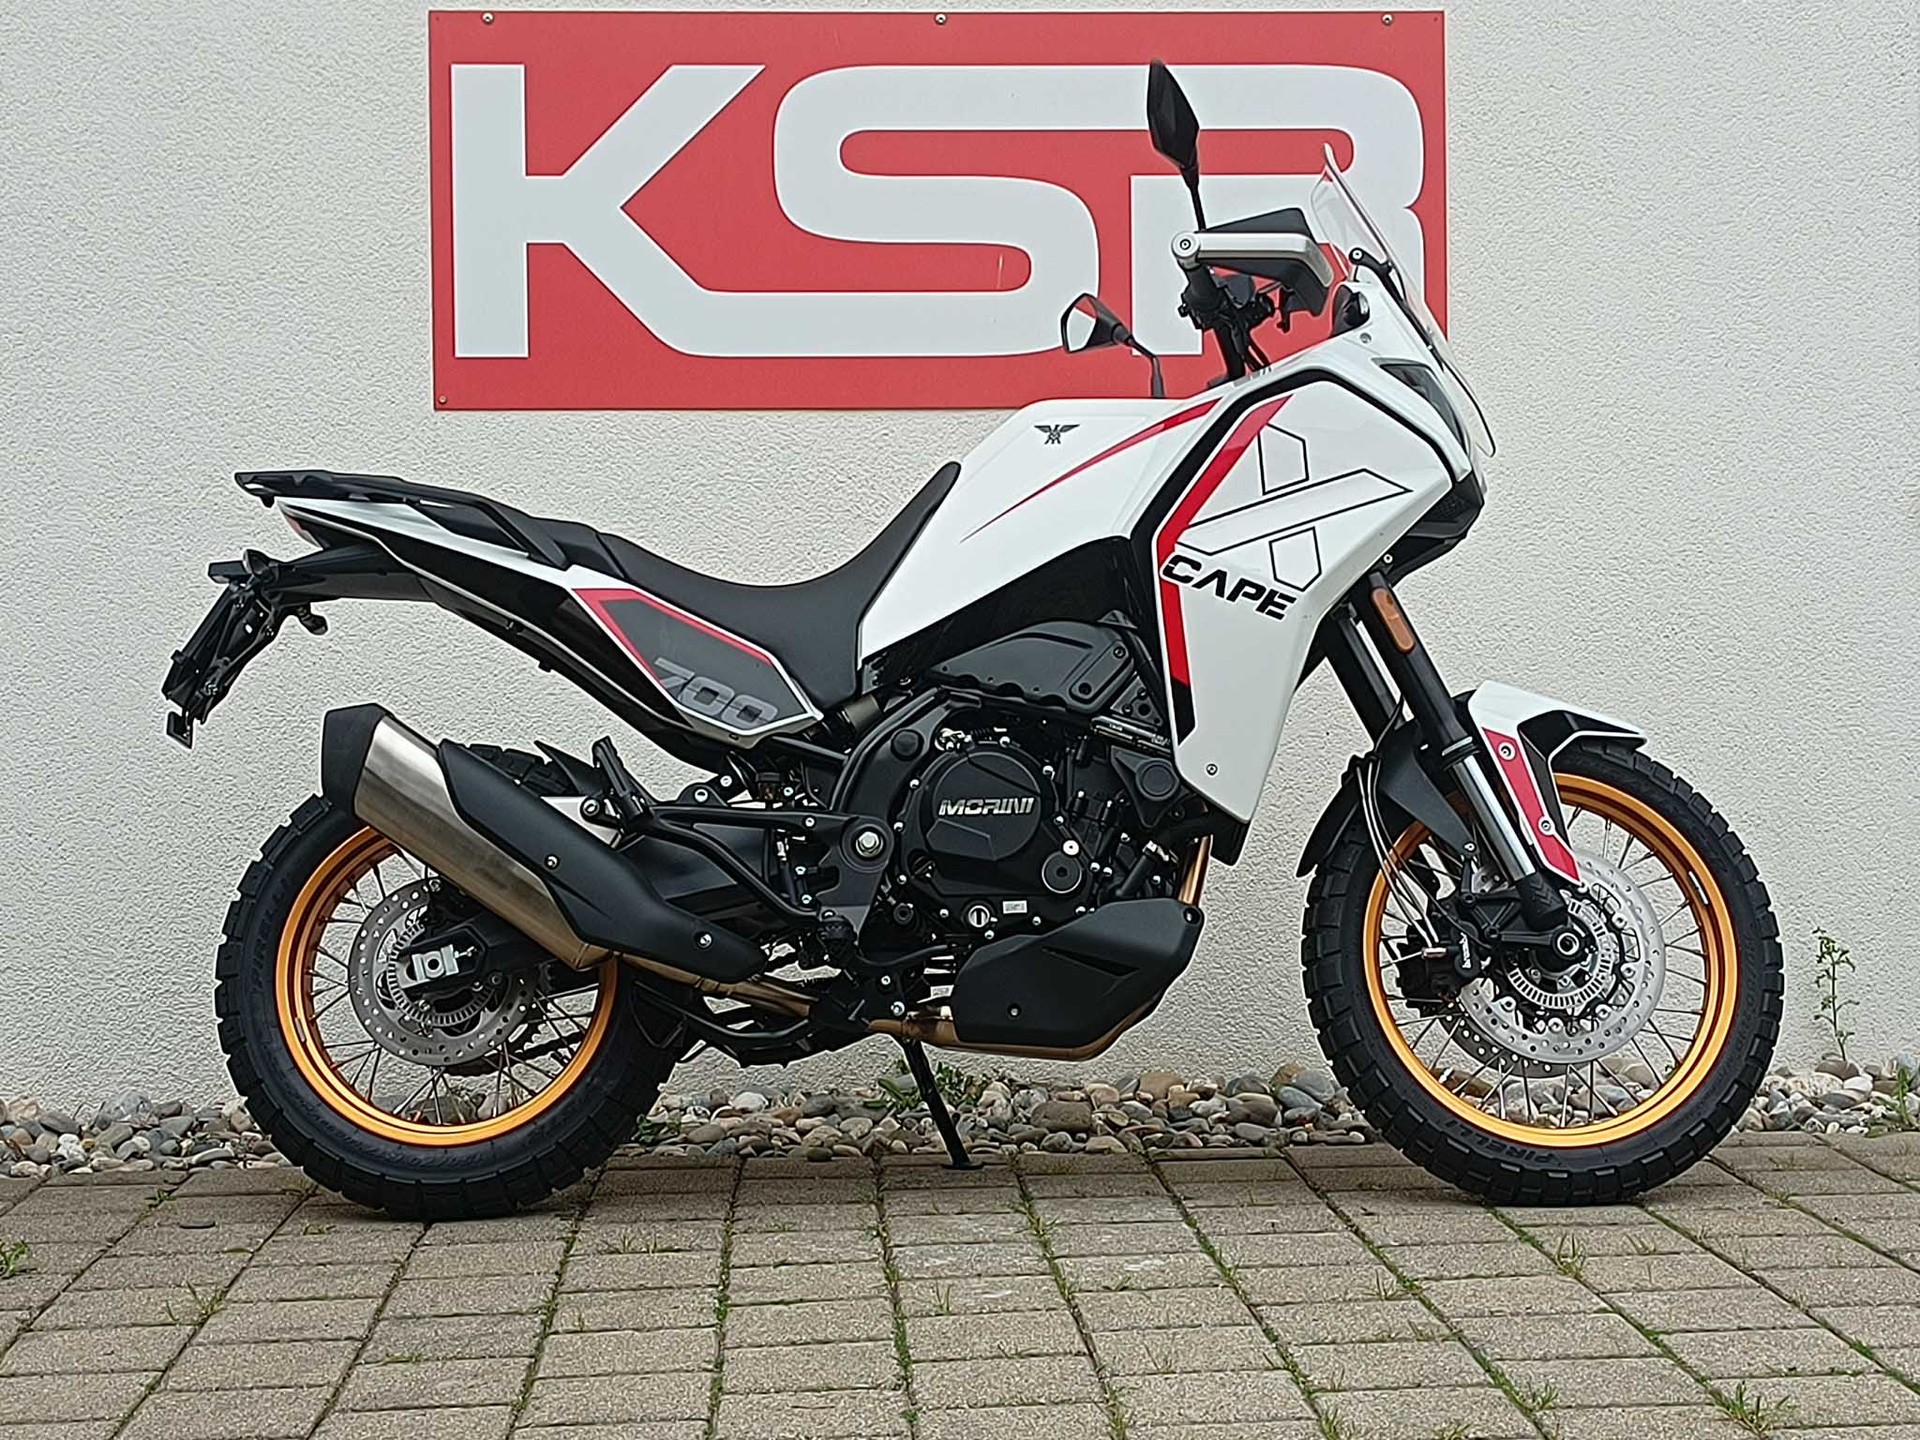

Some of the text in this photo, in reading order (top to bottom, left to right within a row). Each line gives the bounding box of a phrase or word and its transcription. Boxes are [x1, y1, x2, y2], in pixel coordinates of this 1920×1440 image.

[1162, 554, 1297, 620] CAPE
[654, 657, 778, 729] 700
[938, 797, 1034, 816] MORINI
[1444, 1120, 1561, 1166] PIRELLI
